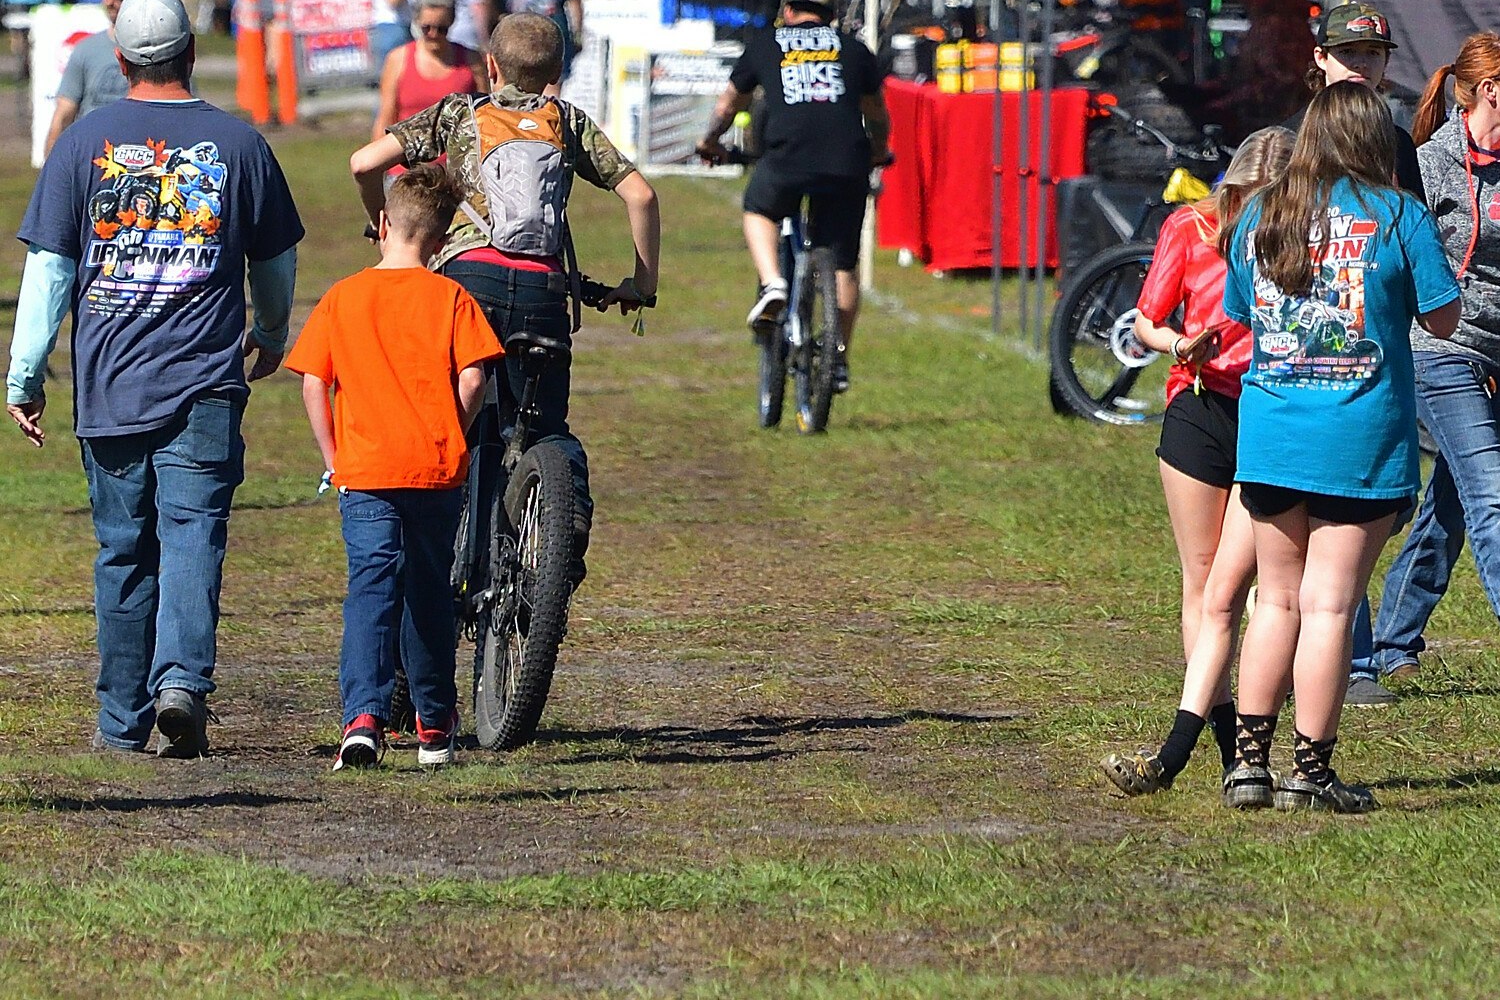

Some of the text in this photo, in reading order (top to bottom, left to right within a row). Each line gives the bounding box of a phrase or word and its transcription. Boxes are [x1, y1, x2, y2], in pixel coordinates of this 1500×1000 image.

[781, 61, 844, 86] BIKE
[783, 83, 847, 105] SHOP
[115, 150, 154, 161] GNCC
[91, 243, 217, 268] IRNMAN
